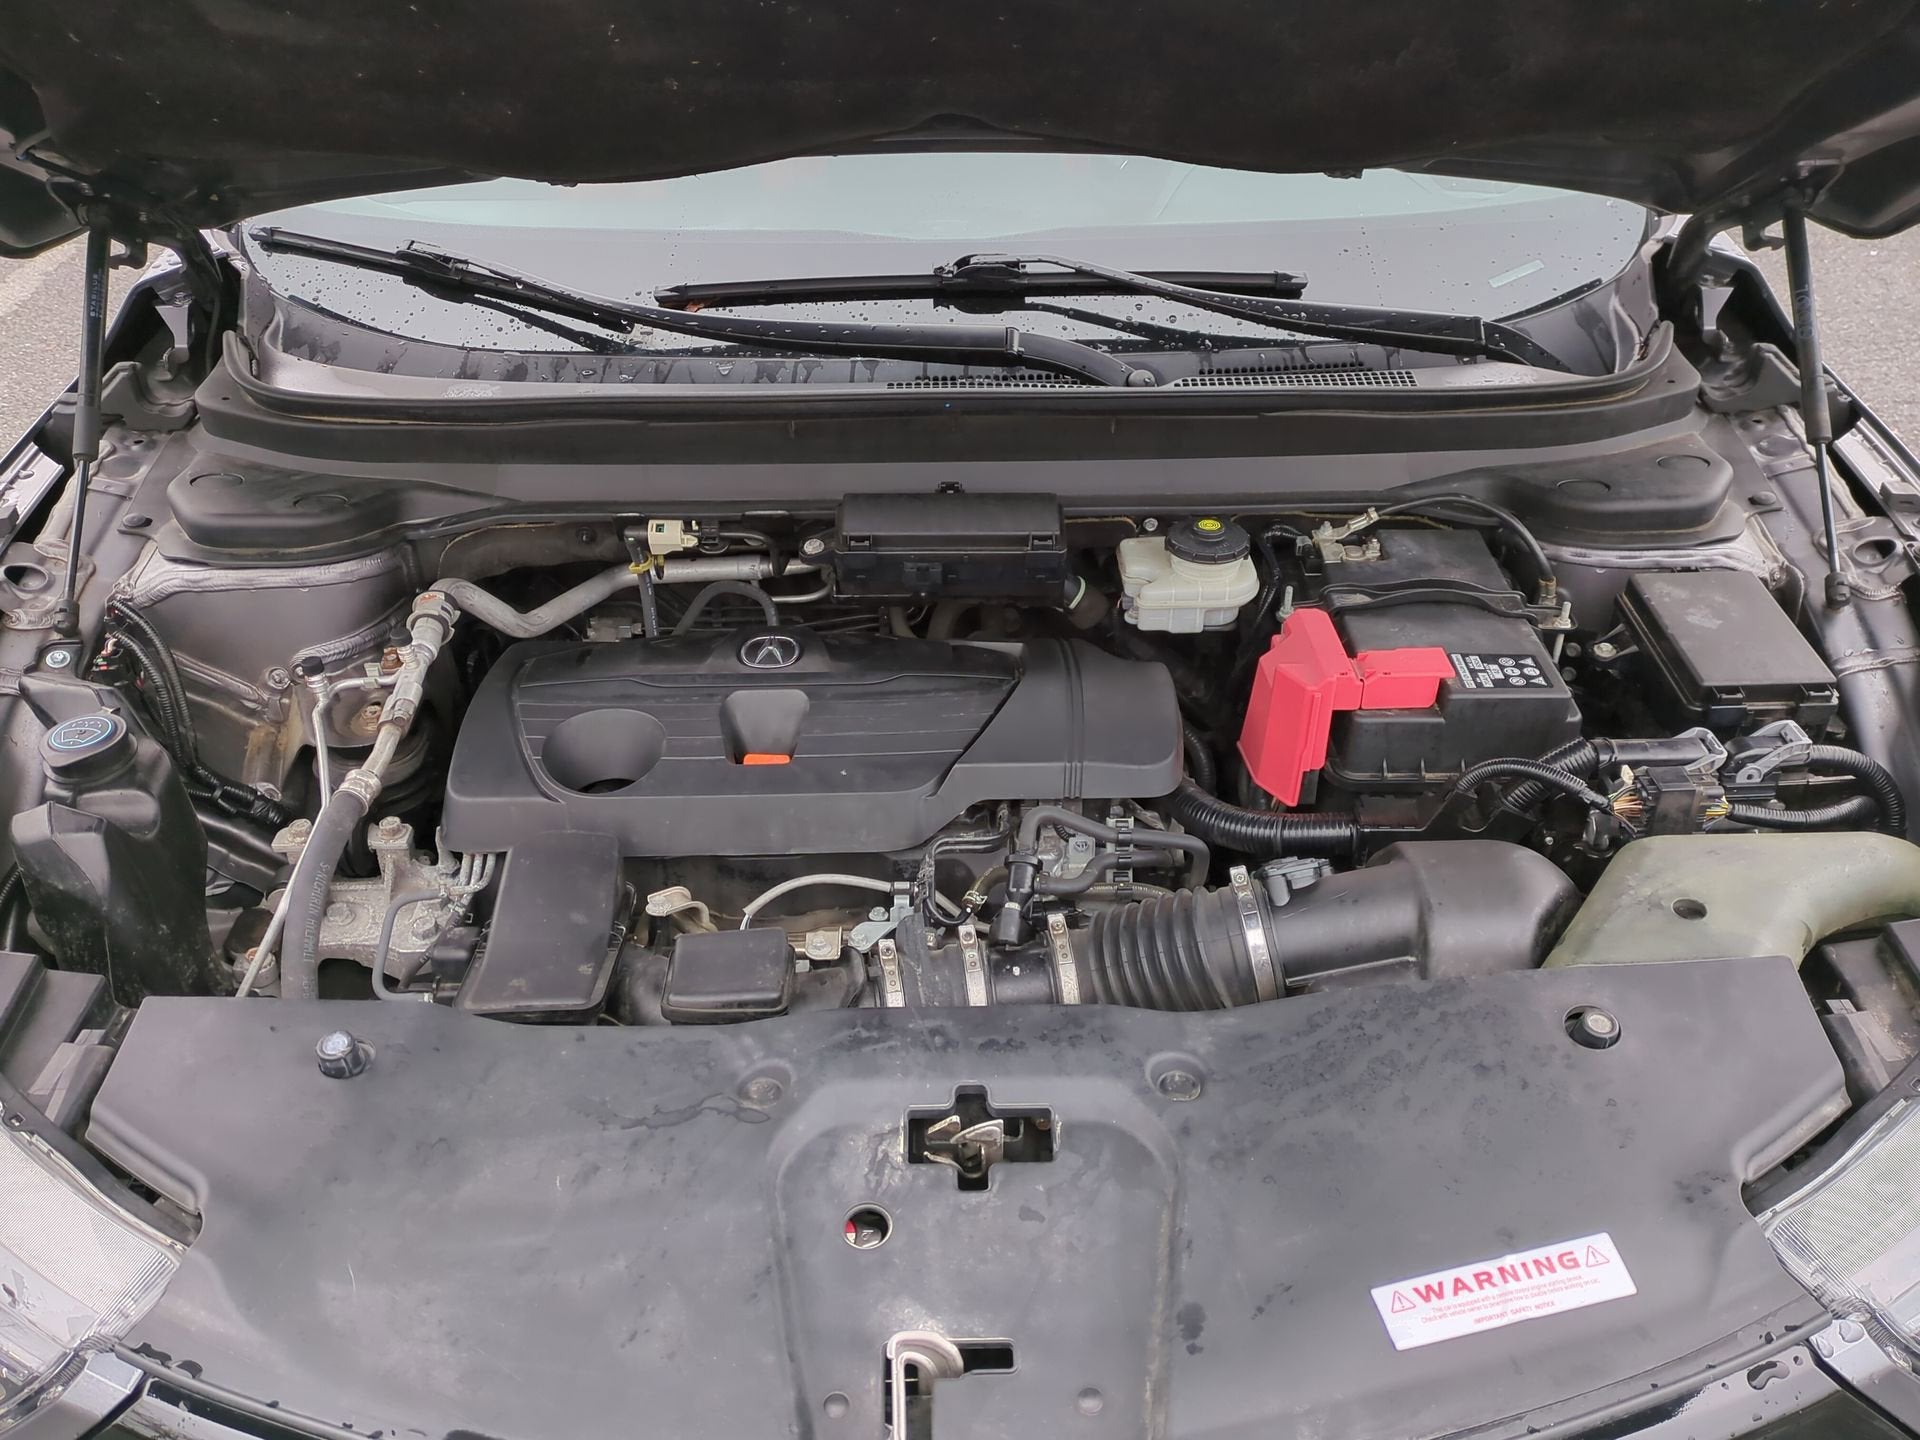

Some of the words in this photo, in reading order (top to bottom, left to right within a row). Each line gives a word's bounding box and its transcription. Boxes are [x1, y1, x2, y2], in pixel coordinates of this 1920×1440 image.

[90, 274, 98, 317] STABILUS
[1413, 1251, 1581, 1303] WARNING
[1474, 1312, 1509, 1324] IMPORTANT
[1510, 1306, 1532, 1316] SAFETY
[1534, 1301, 1556, 1311] NOTICE
